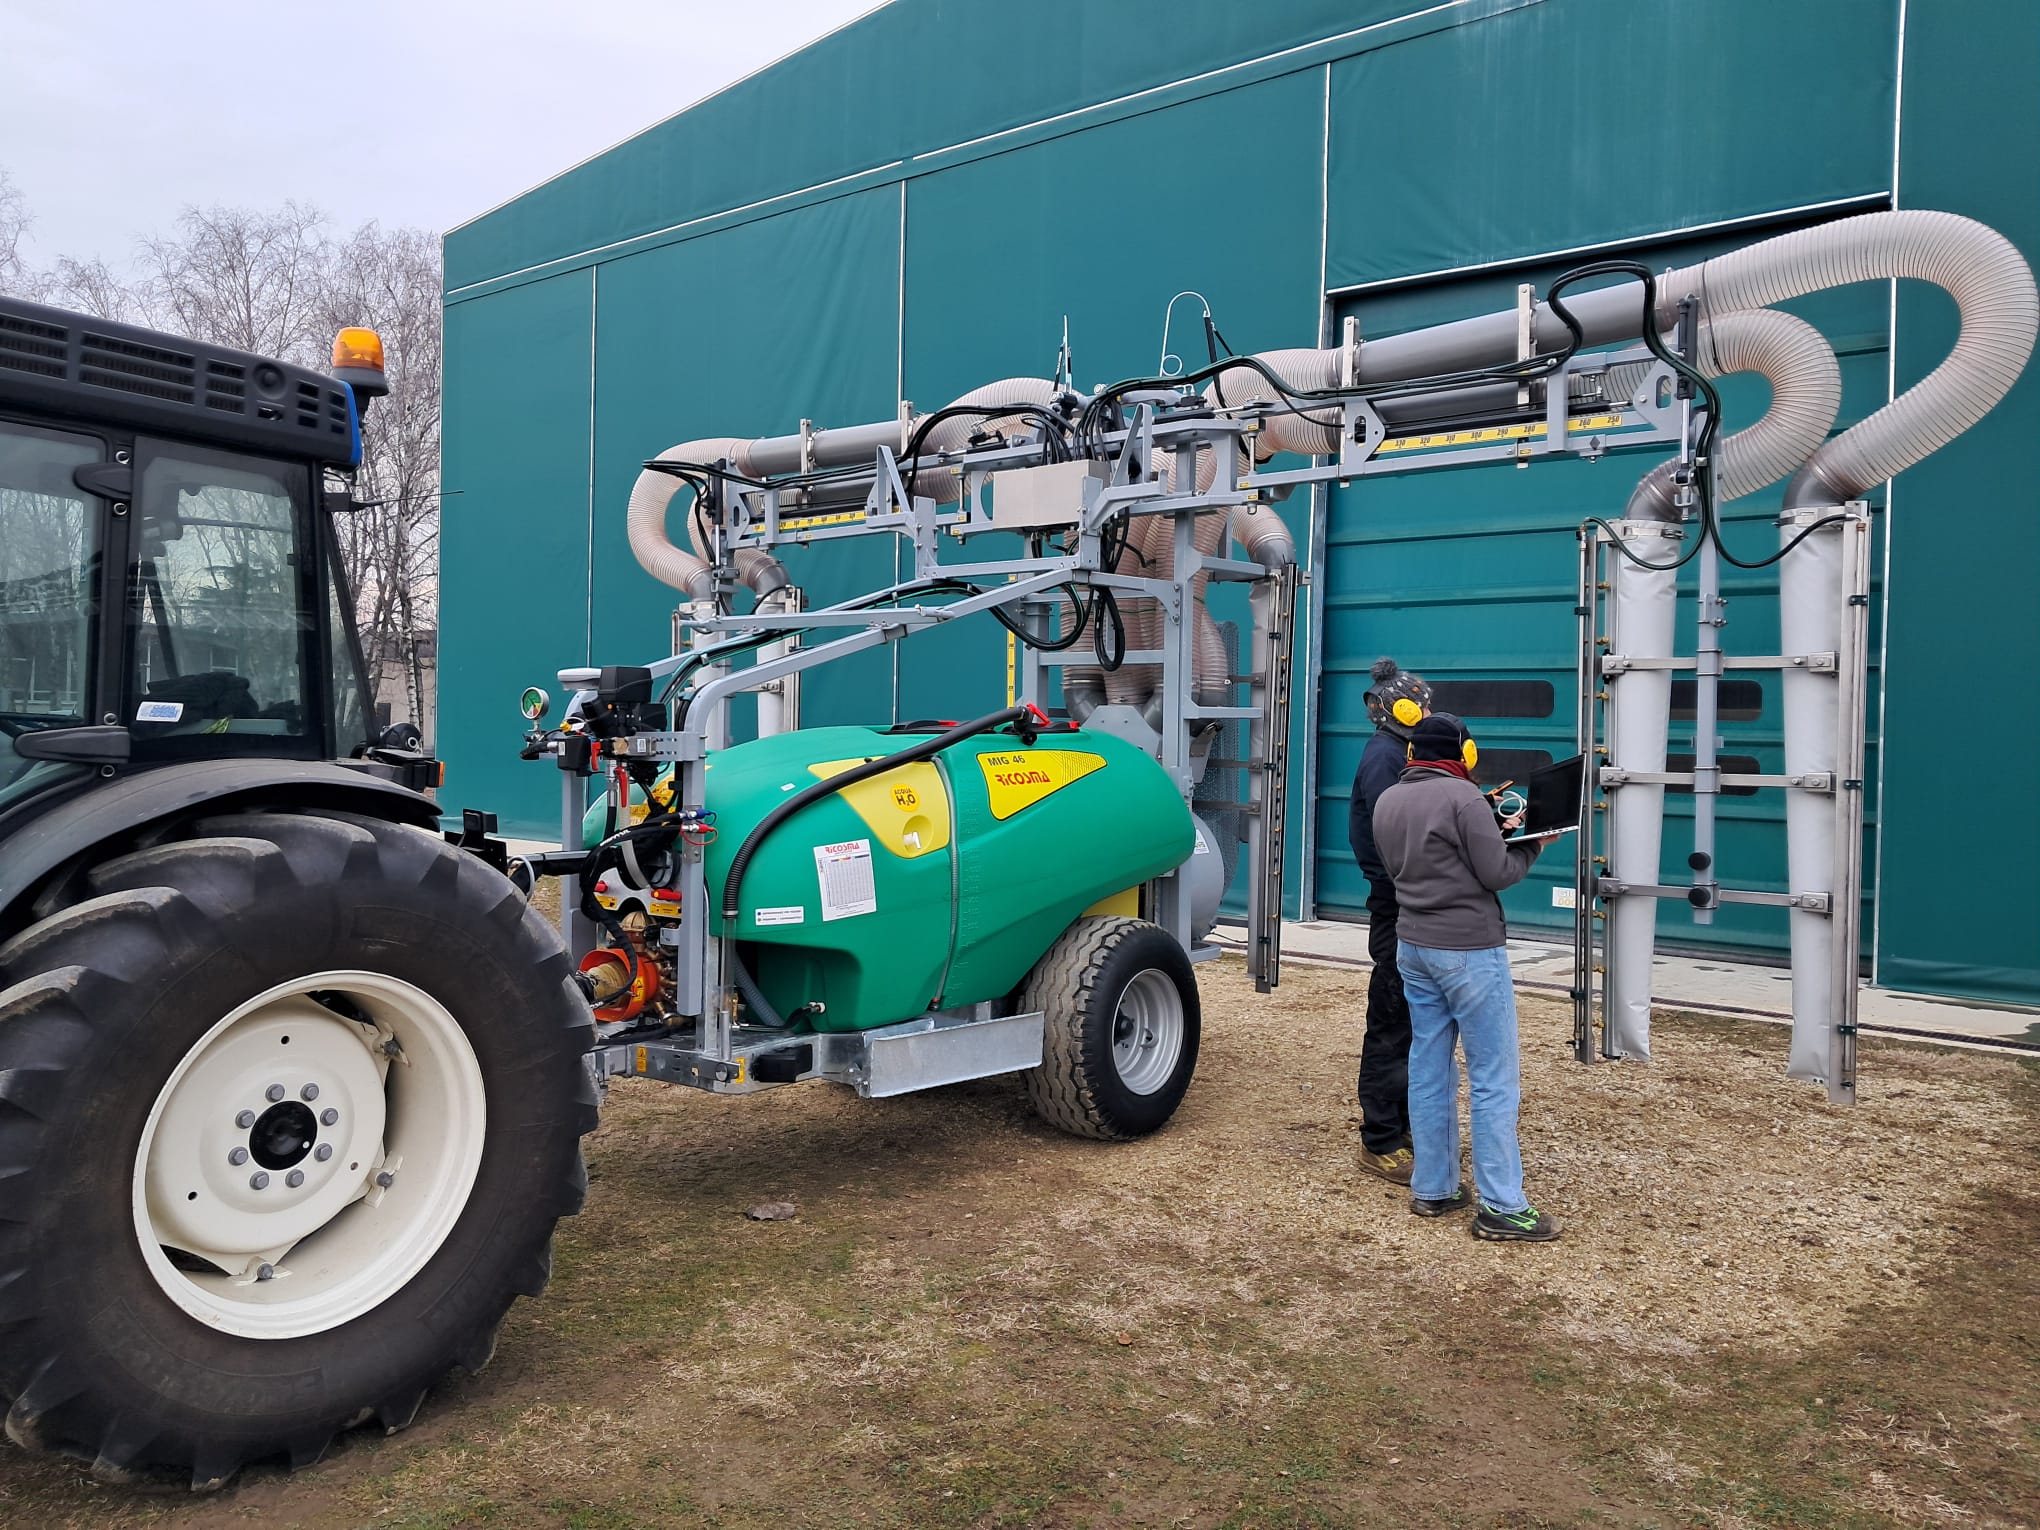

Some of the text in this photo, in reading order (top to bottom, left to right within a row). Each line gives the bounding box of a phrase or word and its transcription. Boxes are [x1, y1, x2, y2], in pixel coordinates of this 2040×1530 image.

[1420, 437, 1431, 445] 320
[1607, 415, 1620, 424] 250
[987, 755, 1026, 767] MIG 46
